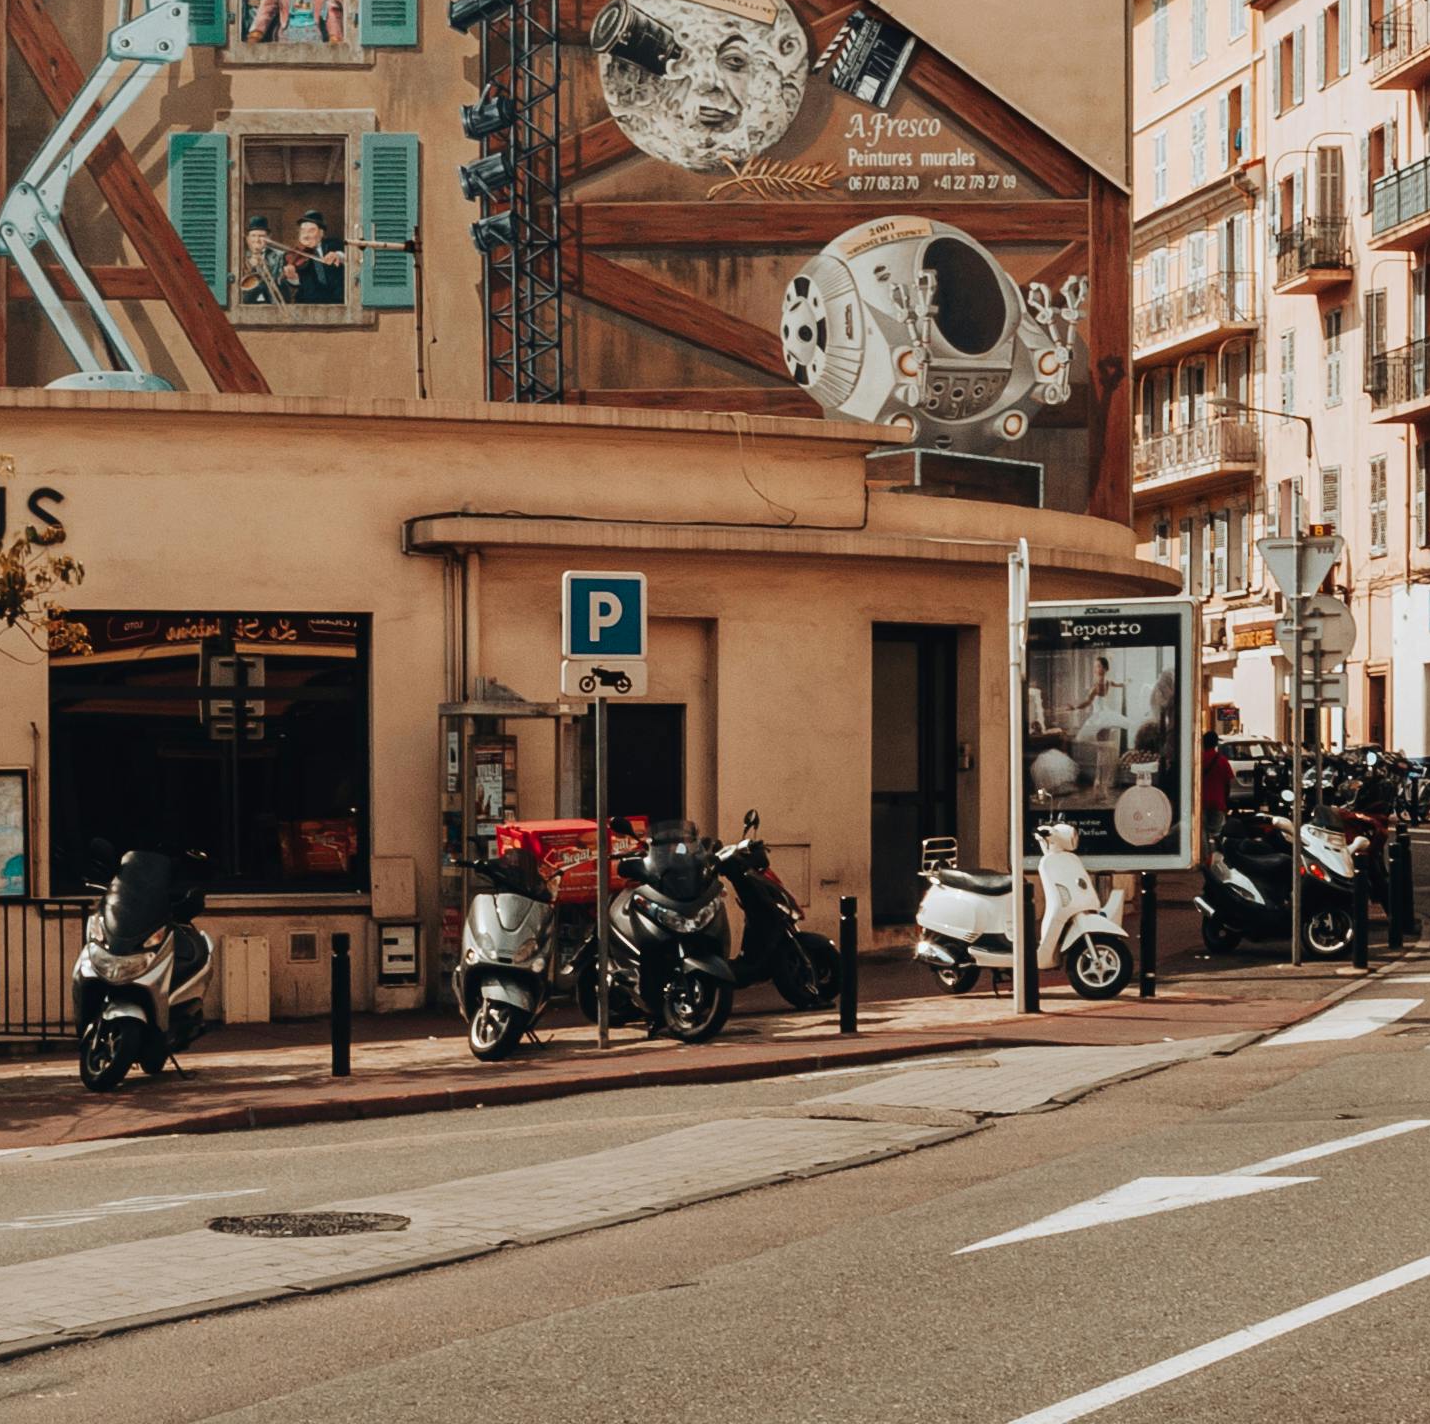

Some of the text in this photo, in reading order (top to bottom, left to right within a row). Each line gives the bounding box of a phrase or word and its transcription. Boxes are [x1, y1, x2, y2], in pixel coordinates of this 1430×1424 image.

[844, 112, 941, 147] A.Fresco
[848, 148, 975, 167] Peintures murales
[848, 176, 862, 191] 06
[864, 176, 876, 191] 77
[891, 176, 904, 191] 23
[906, 176, 919, 191] 70
[953, 175, 966, 190] 22
[987, 175, 1000, 190] 27
[1003, 175, 1016, 190] 09
[588, 591, 623, 642] P
[1060, 619, 1142, 641] repetto
